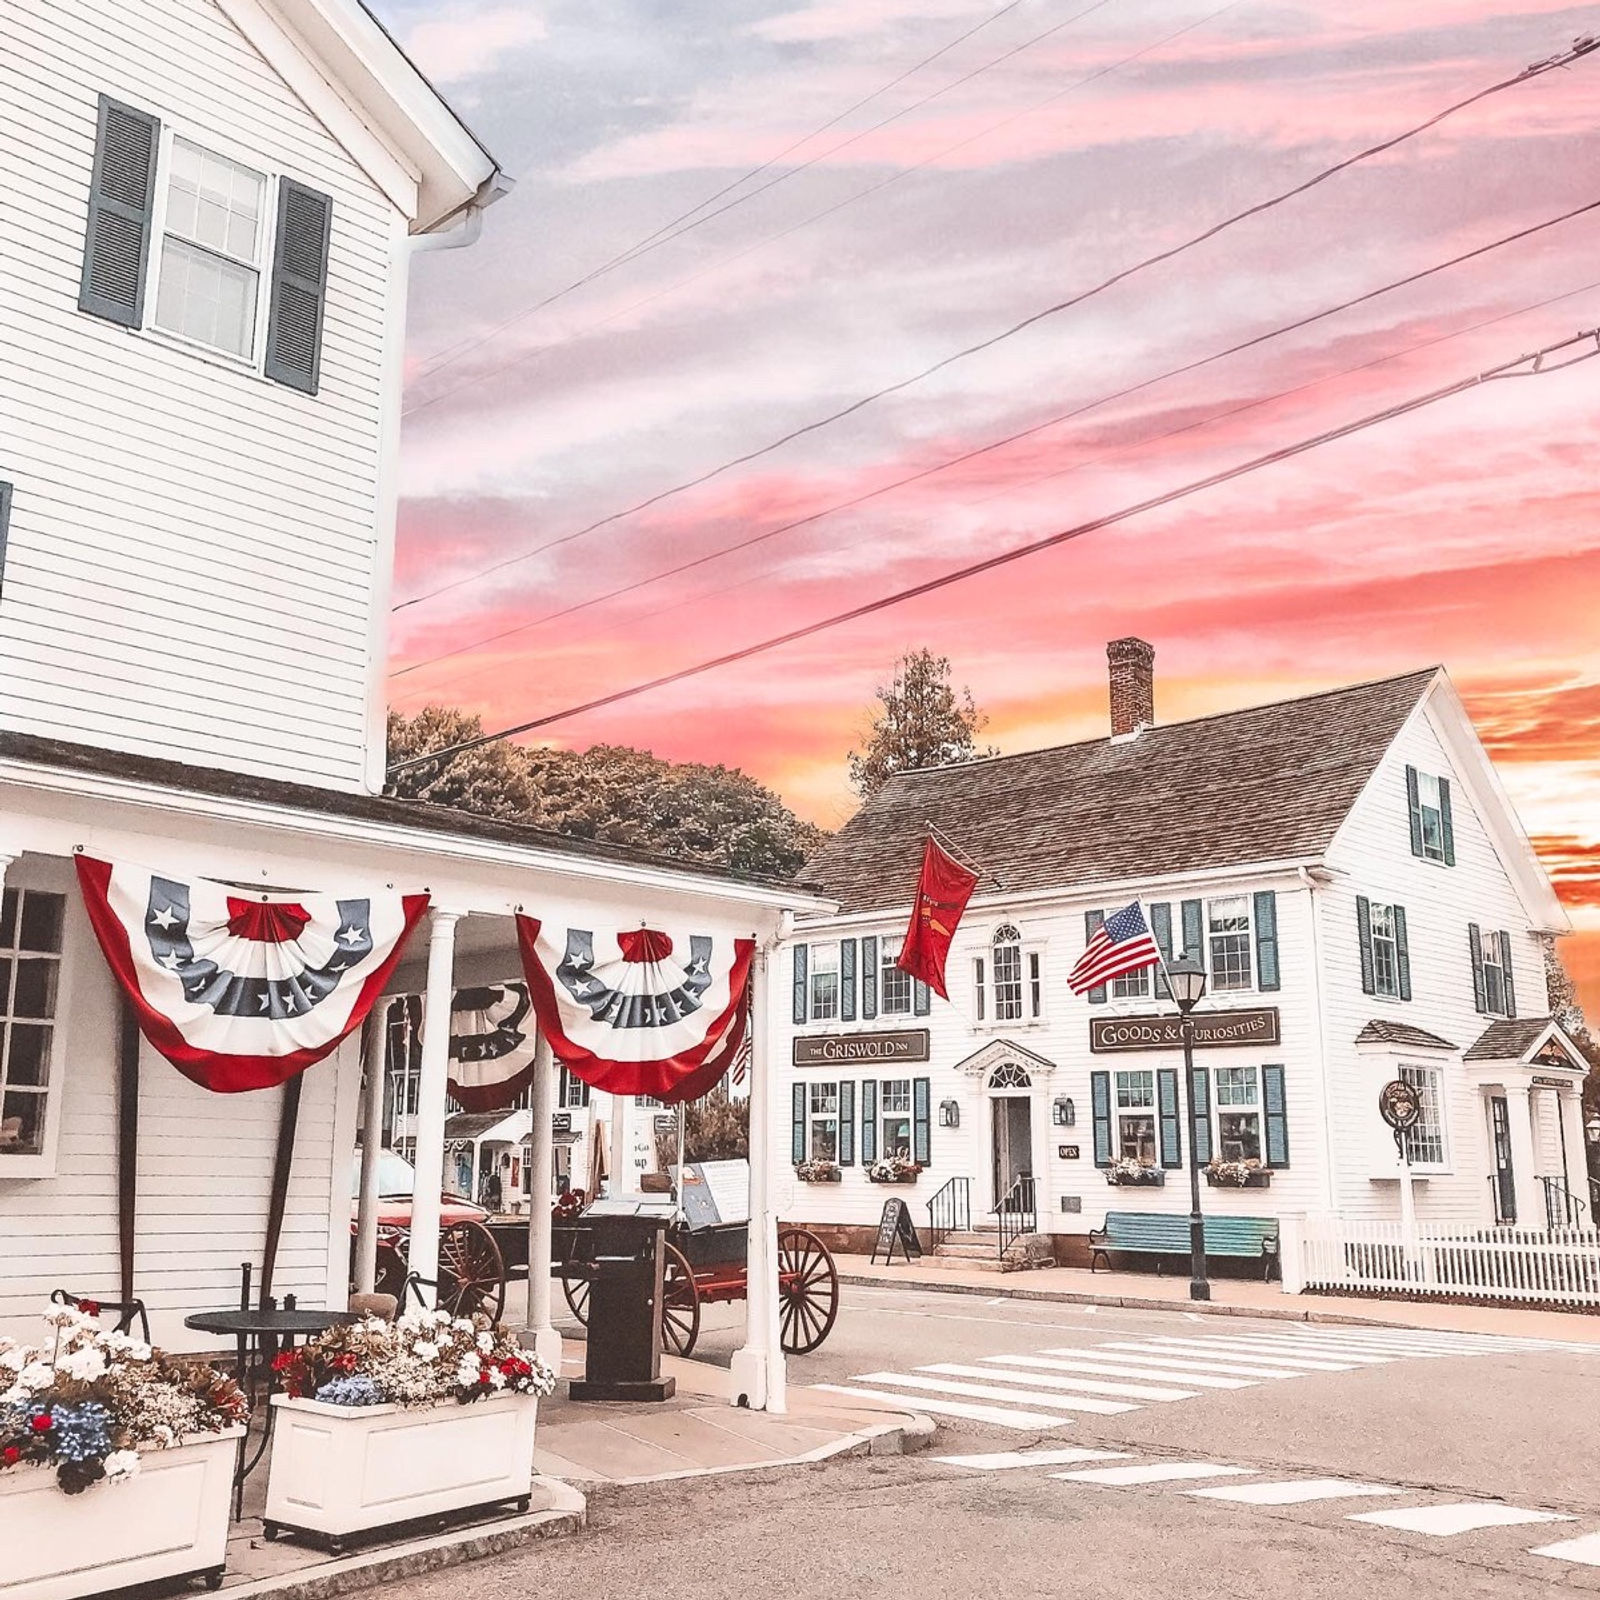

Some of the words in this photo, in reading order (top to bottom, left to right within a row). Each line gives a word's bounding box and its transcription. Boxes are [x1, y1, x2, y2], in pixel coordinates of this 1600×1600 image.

[1101, 1025, 1162, 1045] GOODS
[1164, 1025, 1179, 1040] &
[810, 1047, 822, 1056] THE
[823, 1040, 895, 1059] GRISWOLD
